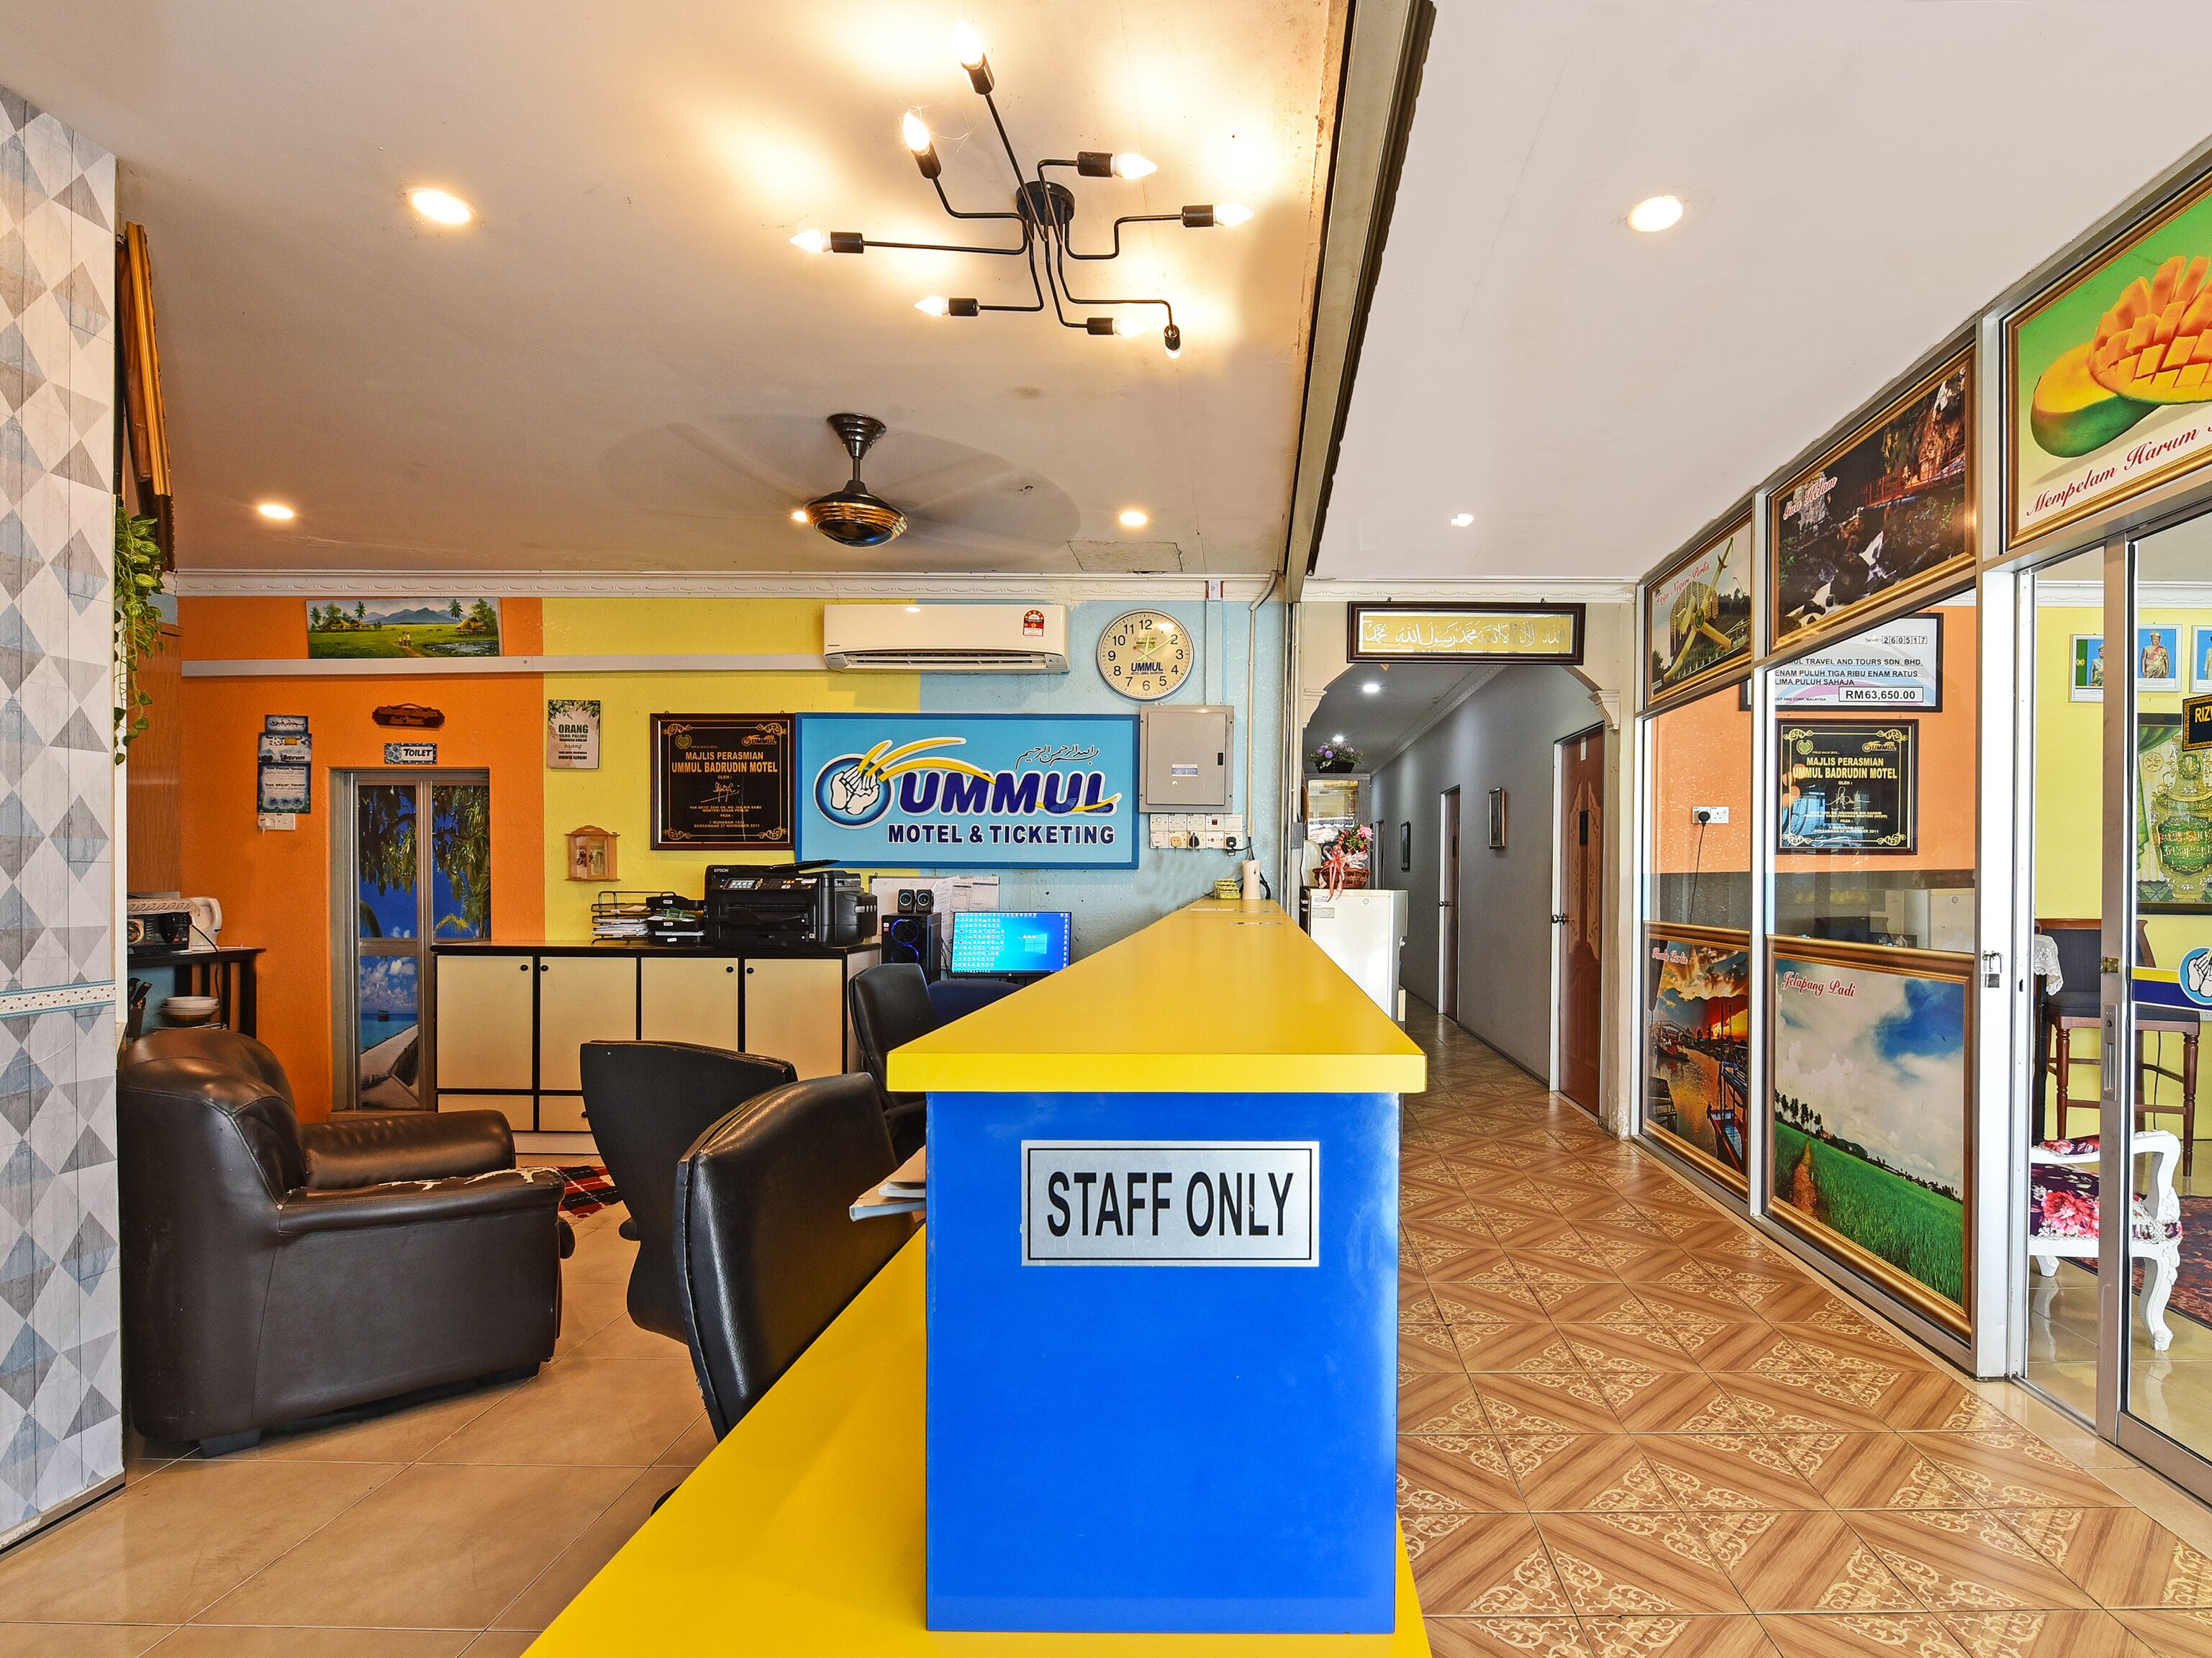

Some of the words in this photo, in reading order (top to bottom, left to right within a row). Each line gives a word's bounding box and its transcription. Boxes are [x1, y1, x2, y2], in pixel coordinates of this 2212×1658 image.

[2026, 467, 2118, 516] Mempelam
[2124, 428, 2199, 470] Harum
[1783, 501, 1802, 520] Gua
[1803, 476, 1837, 506] Kelam
[1124, 624, 1134, 634] 11
[1139, 620, 1152, 630] 12
[1112, 635, 1125, 645] 10
[1171, 635, 1178, 645] 2
[1108, 651, 1116, 661] 9
[1176, 649, 1184, 659] 3
[1113, 666, 1121, 676] 8
[1131, 662, 1163, 671] UMMUL
[1171, 665, 1179, 675] 4
[1125, 676, 1133, 687] 7
[1142, 680, 1150, 691] 6
[1159, 676, 1166, 686] 5
[558, 724, 589, 733] ORANG
[1806, 757, 1836, 766] MAJLIS
[1838, 757, 1884, 766] PERASMIAN
[671, 762, 702, 773] UMMUL
[704, 762, 747, 773] BADRUDIN
[749, 762, 778, 773] MOTEL
[1792, 767, 1823, 778] UMMUL
[1825, 767, 1867, 778] BADRUDIN
[1870, 768, 1898, 779] MOTEL
[899, 771, 1115, 814] UMMUL
[888, 825, 963, 843] MOTEL
[969, 825, 983, 843] &
[989, 825, 1115, 844] TICKETING
[1782, 971, 1824, 996] Jelapang
[1828, 979, 1856, 997] Padi
[1047, 1172, 1172, 1237] STAFF
[1187, 1172, 1294, 1237] ONLY
